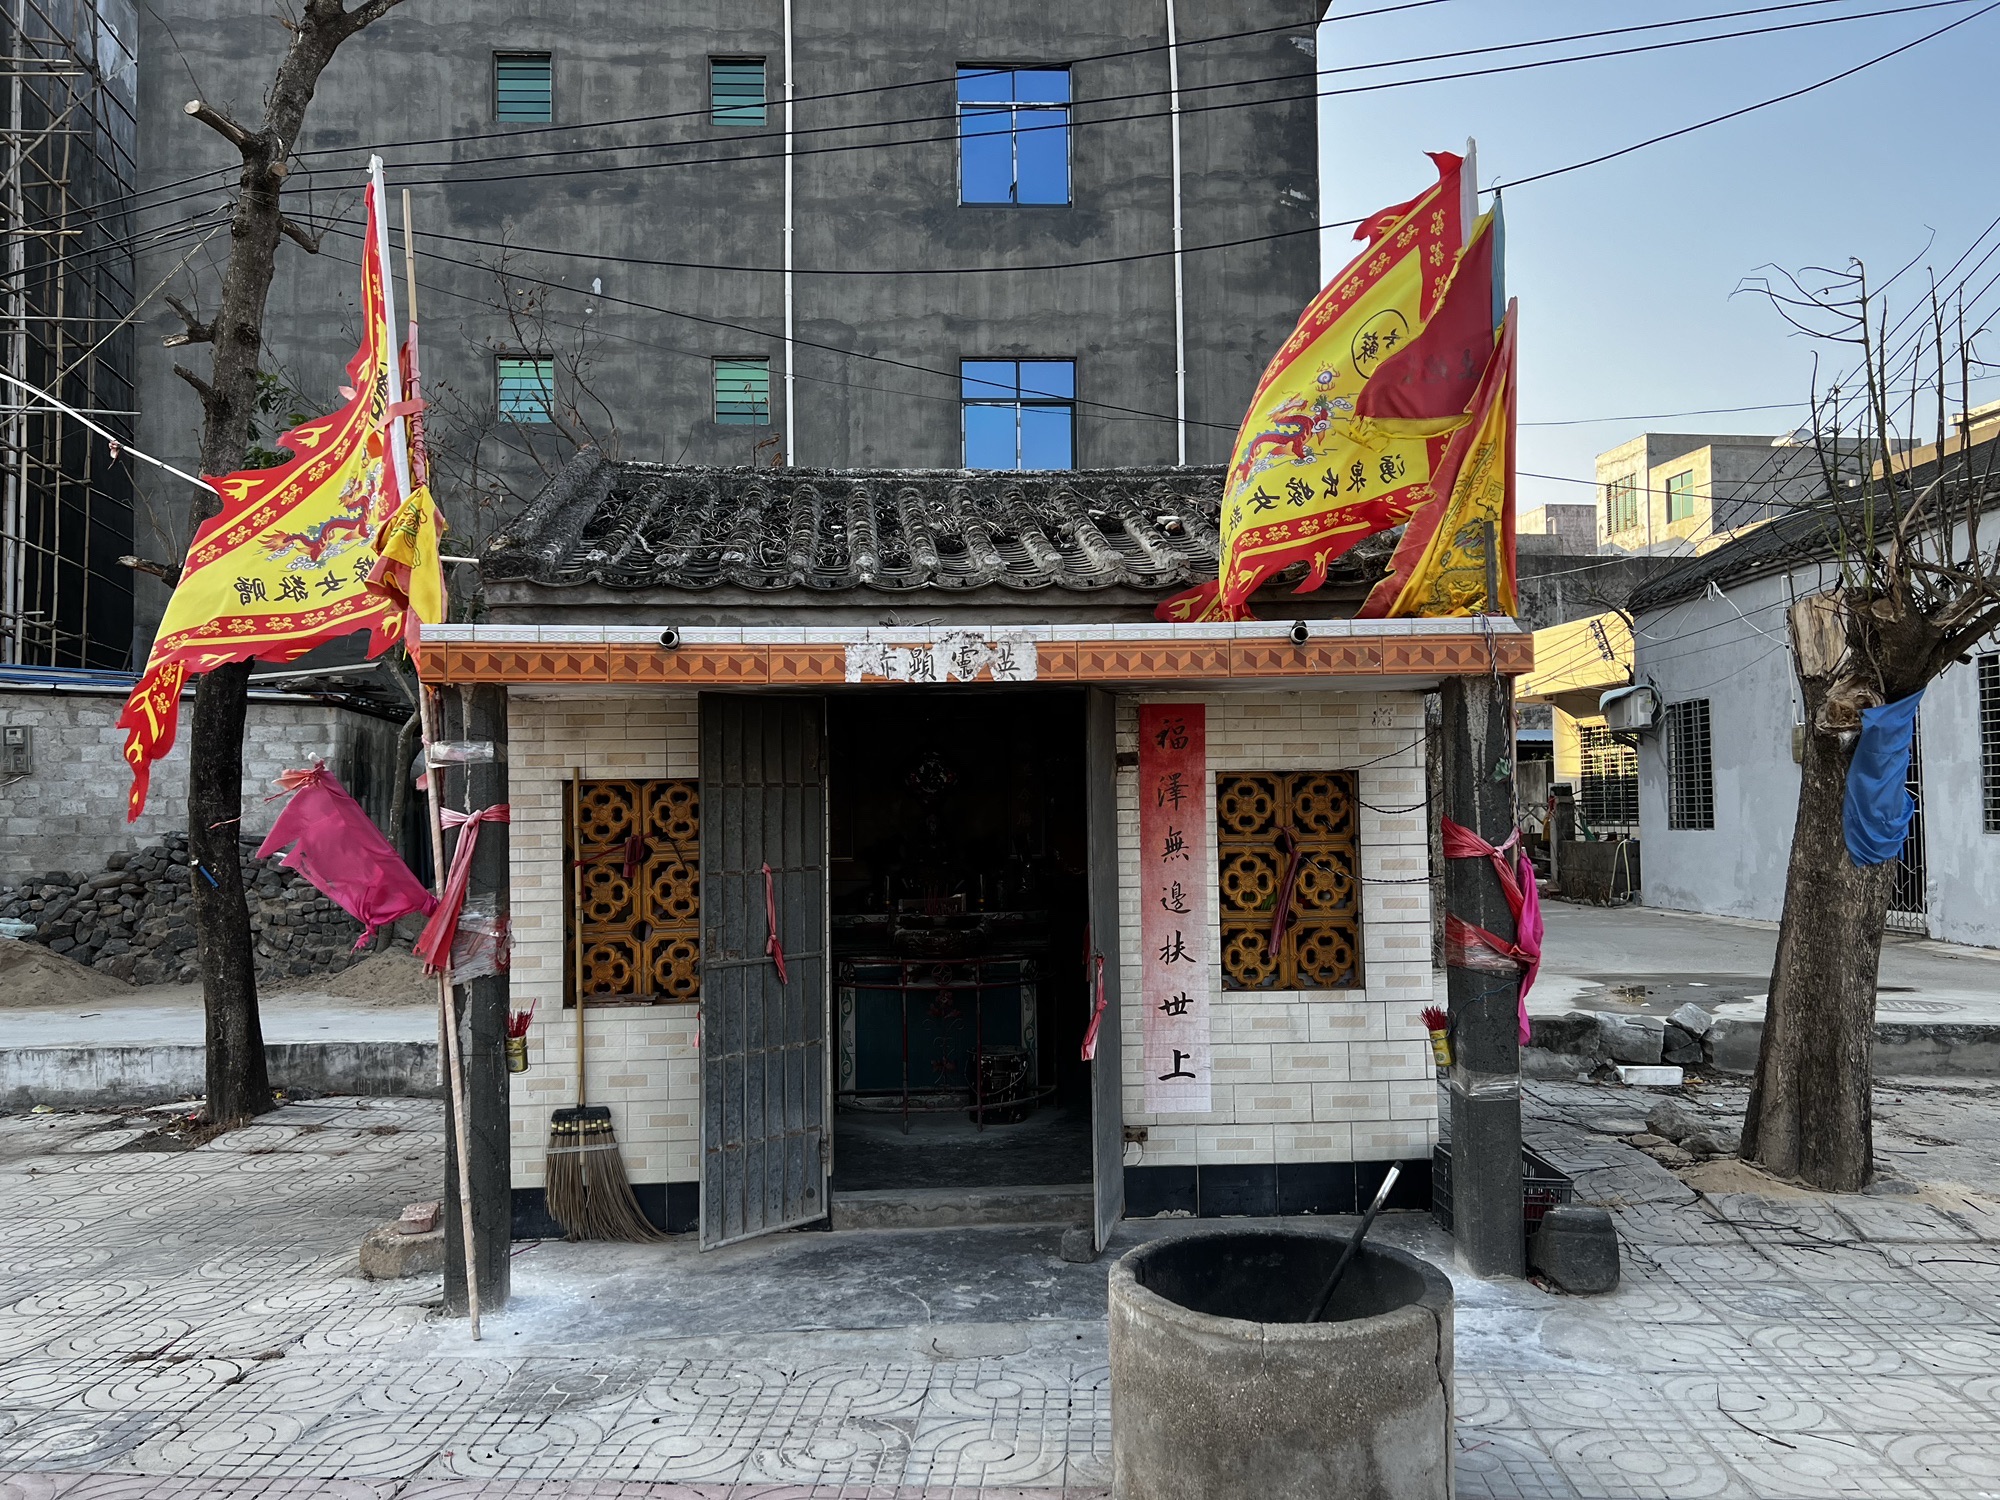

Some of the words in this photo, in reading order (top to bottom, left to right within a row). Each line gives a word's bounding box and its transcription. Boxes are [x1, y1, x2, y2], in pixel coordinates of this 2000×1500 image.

[1156, 718, 1196, 1081] 福澤無邊扶世上
